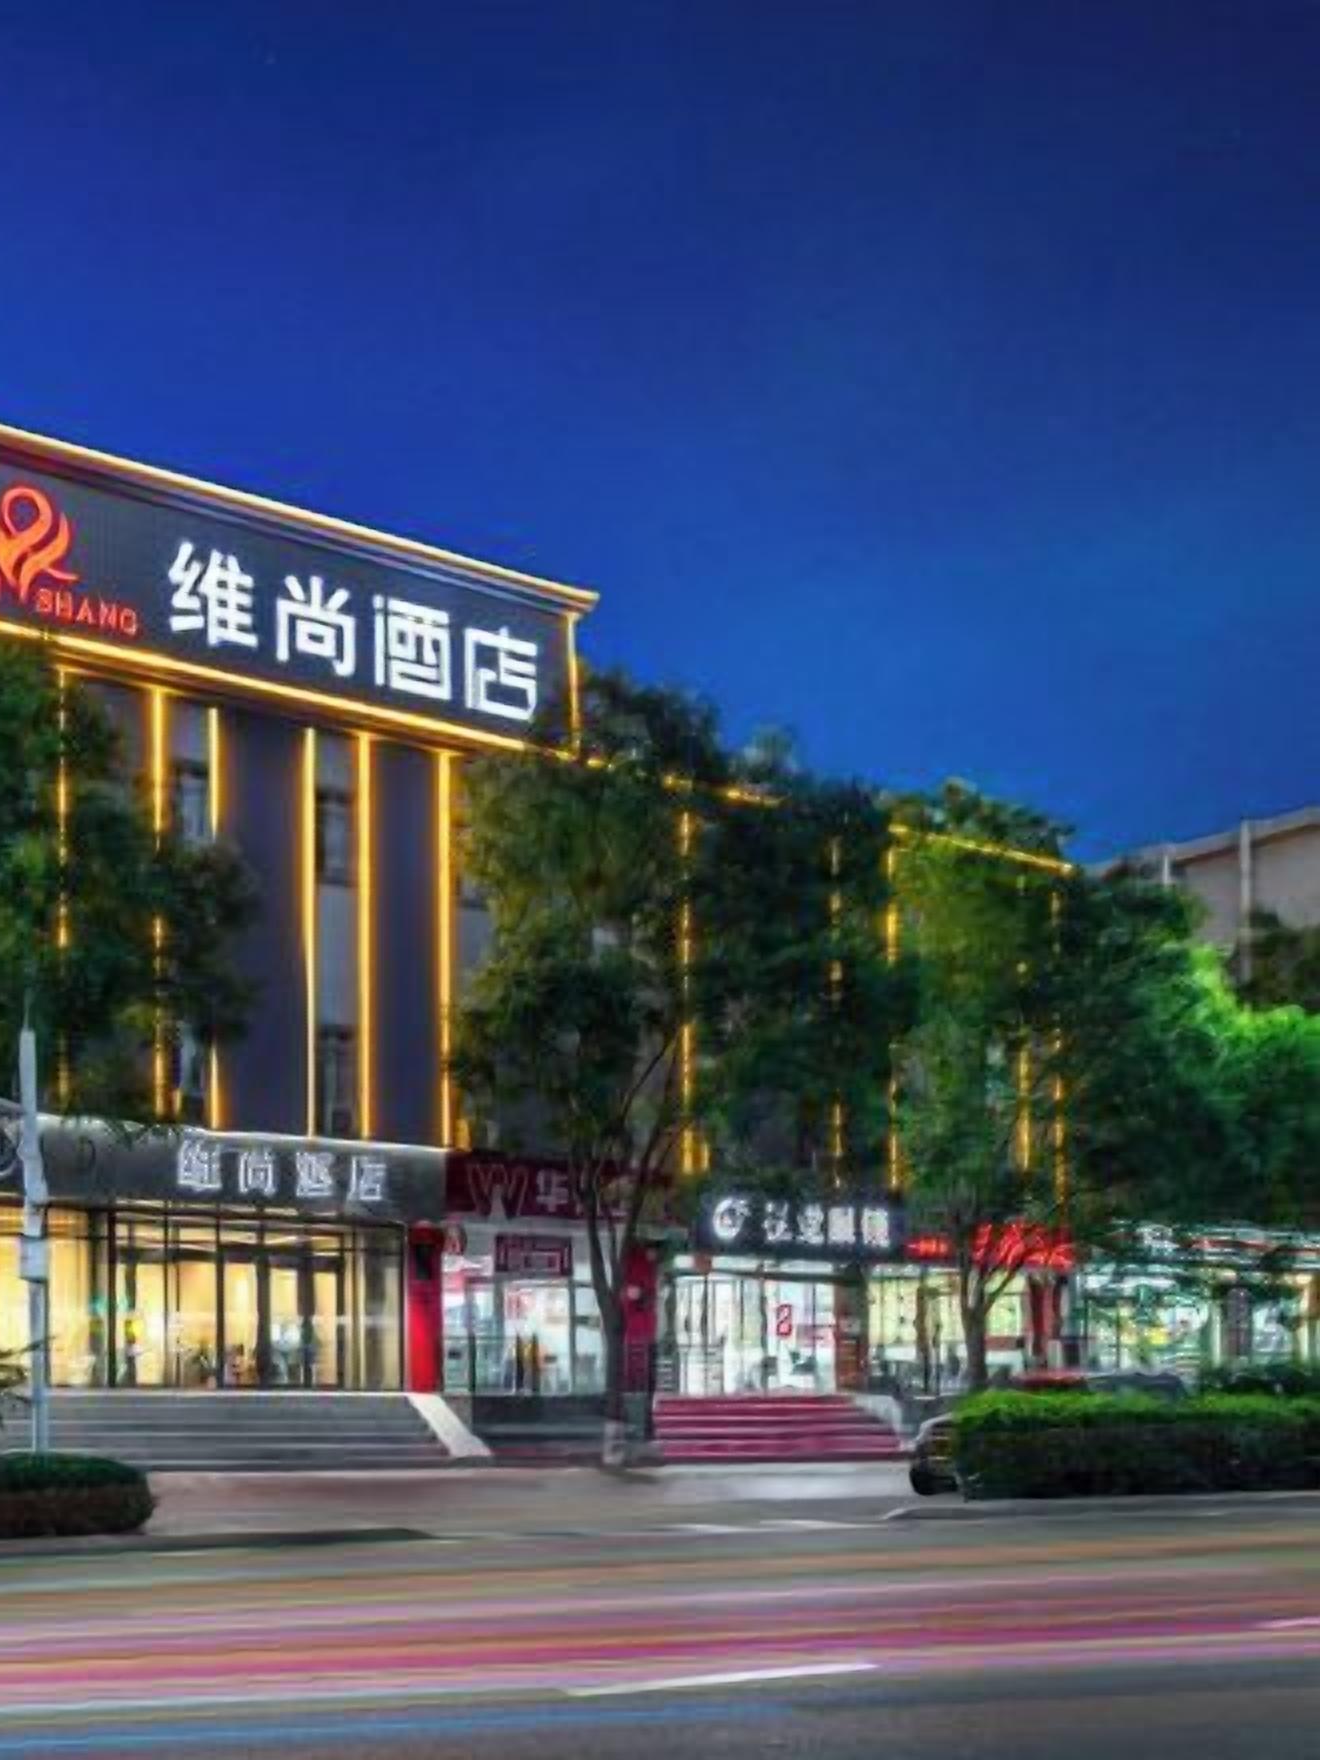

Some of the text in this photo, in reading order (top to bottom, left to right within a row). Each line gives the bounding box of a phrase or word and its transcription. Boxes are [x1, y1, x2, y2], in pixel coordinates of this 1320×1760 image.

[35, 587, 139, 636] SHANG
[167, 541, 538, 722] 维尚酒店
